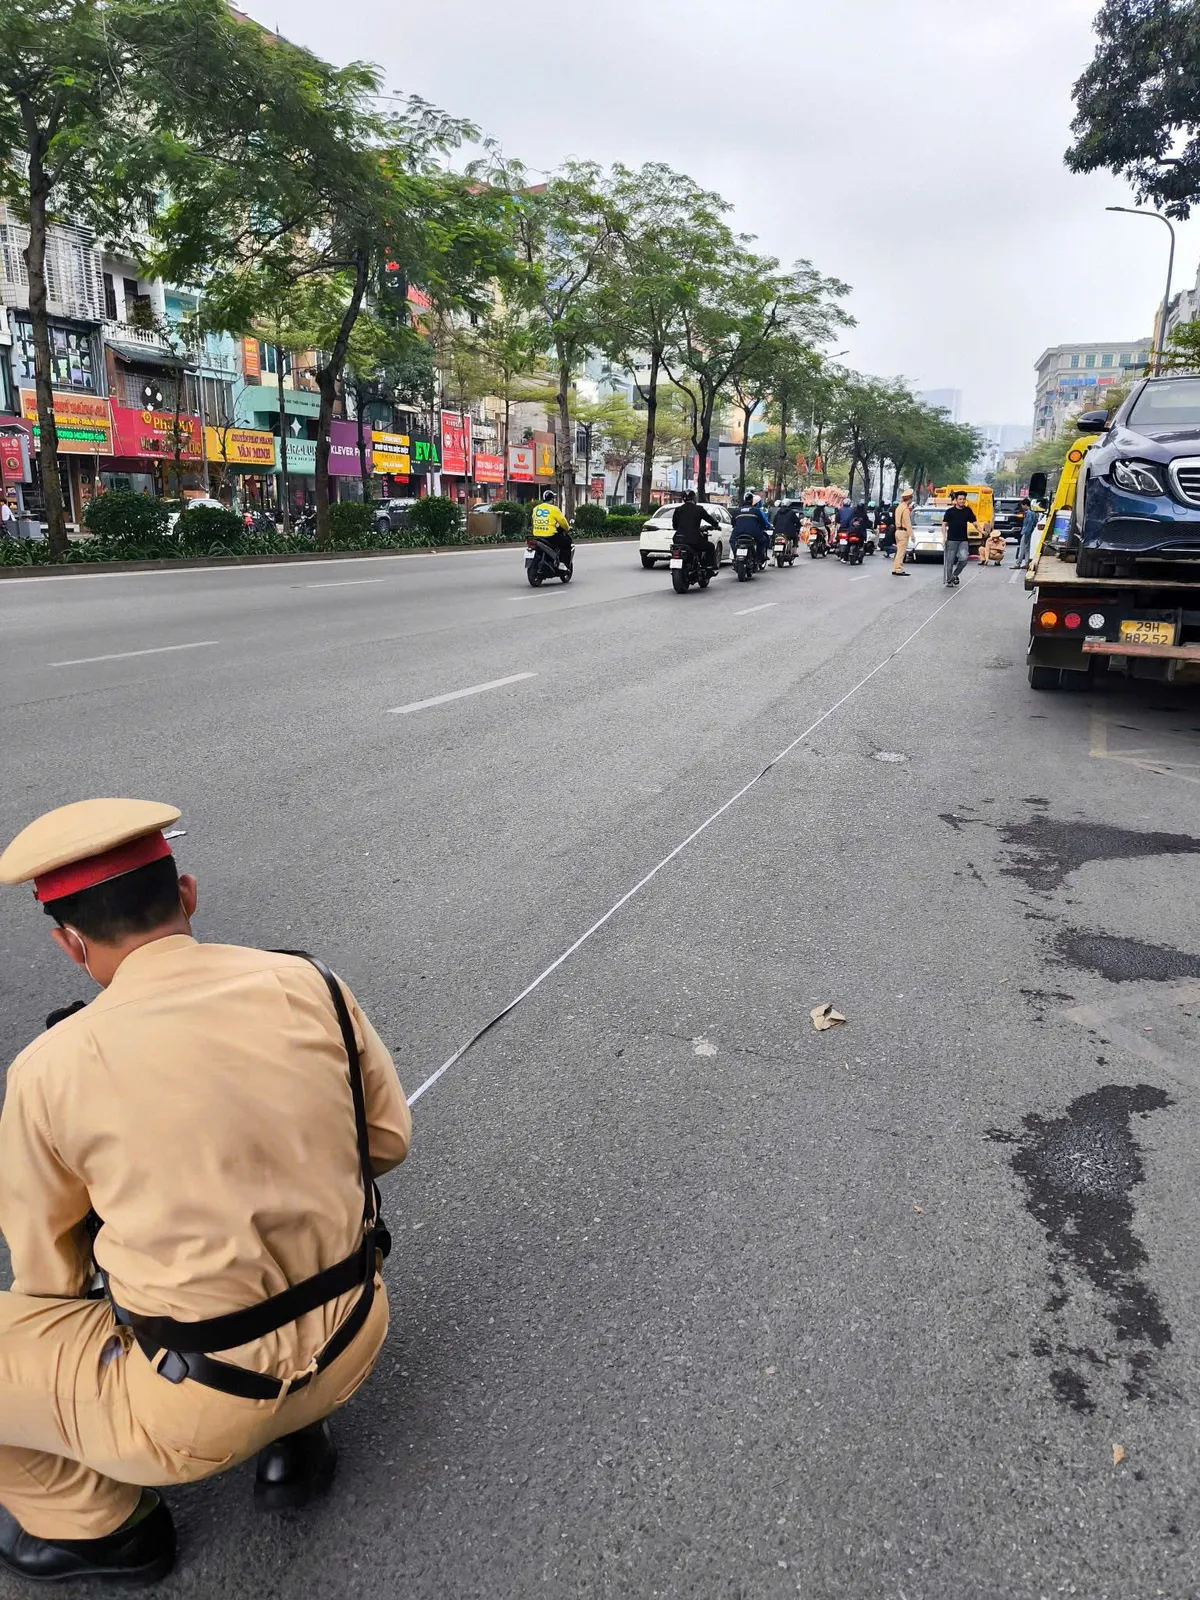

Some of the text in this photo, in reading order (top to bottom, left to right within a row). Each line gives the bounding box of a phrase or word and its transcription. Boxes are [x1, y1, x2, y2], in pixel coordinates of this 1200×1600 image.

[330, 445, 354, 456] KLEVER
[414, 441, 439, 462] EVA
[536, 507, 550, 518] be
[1136, 622, 1160, 633] 29H
